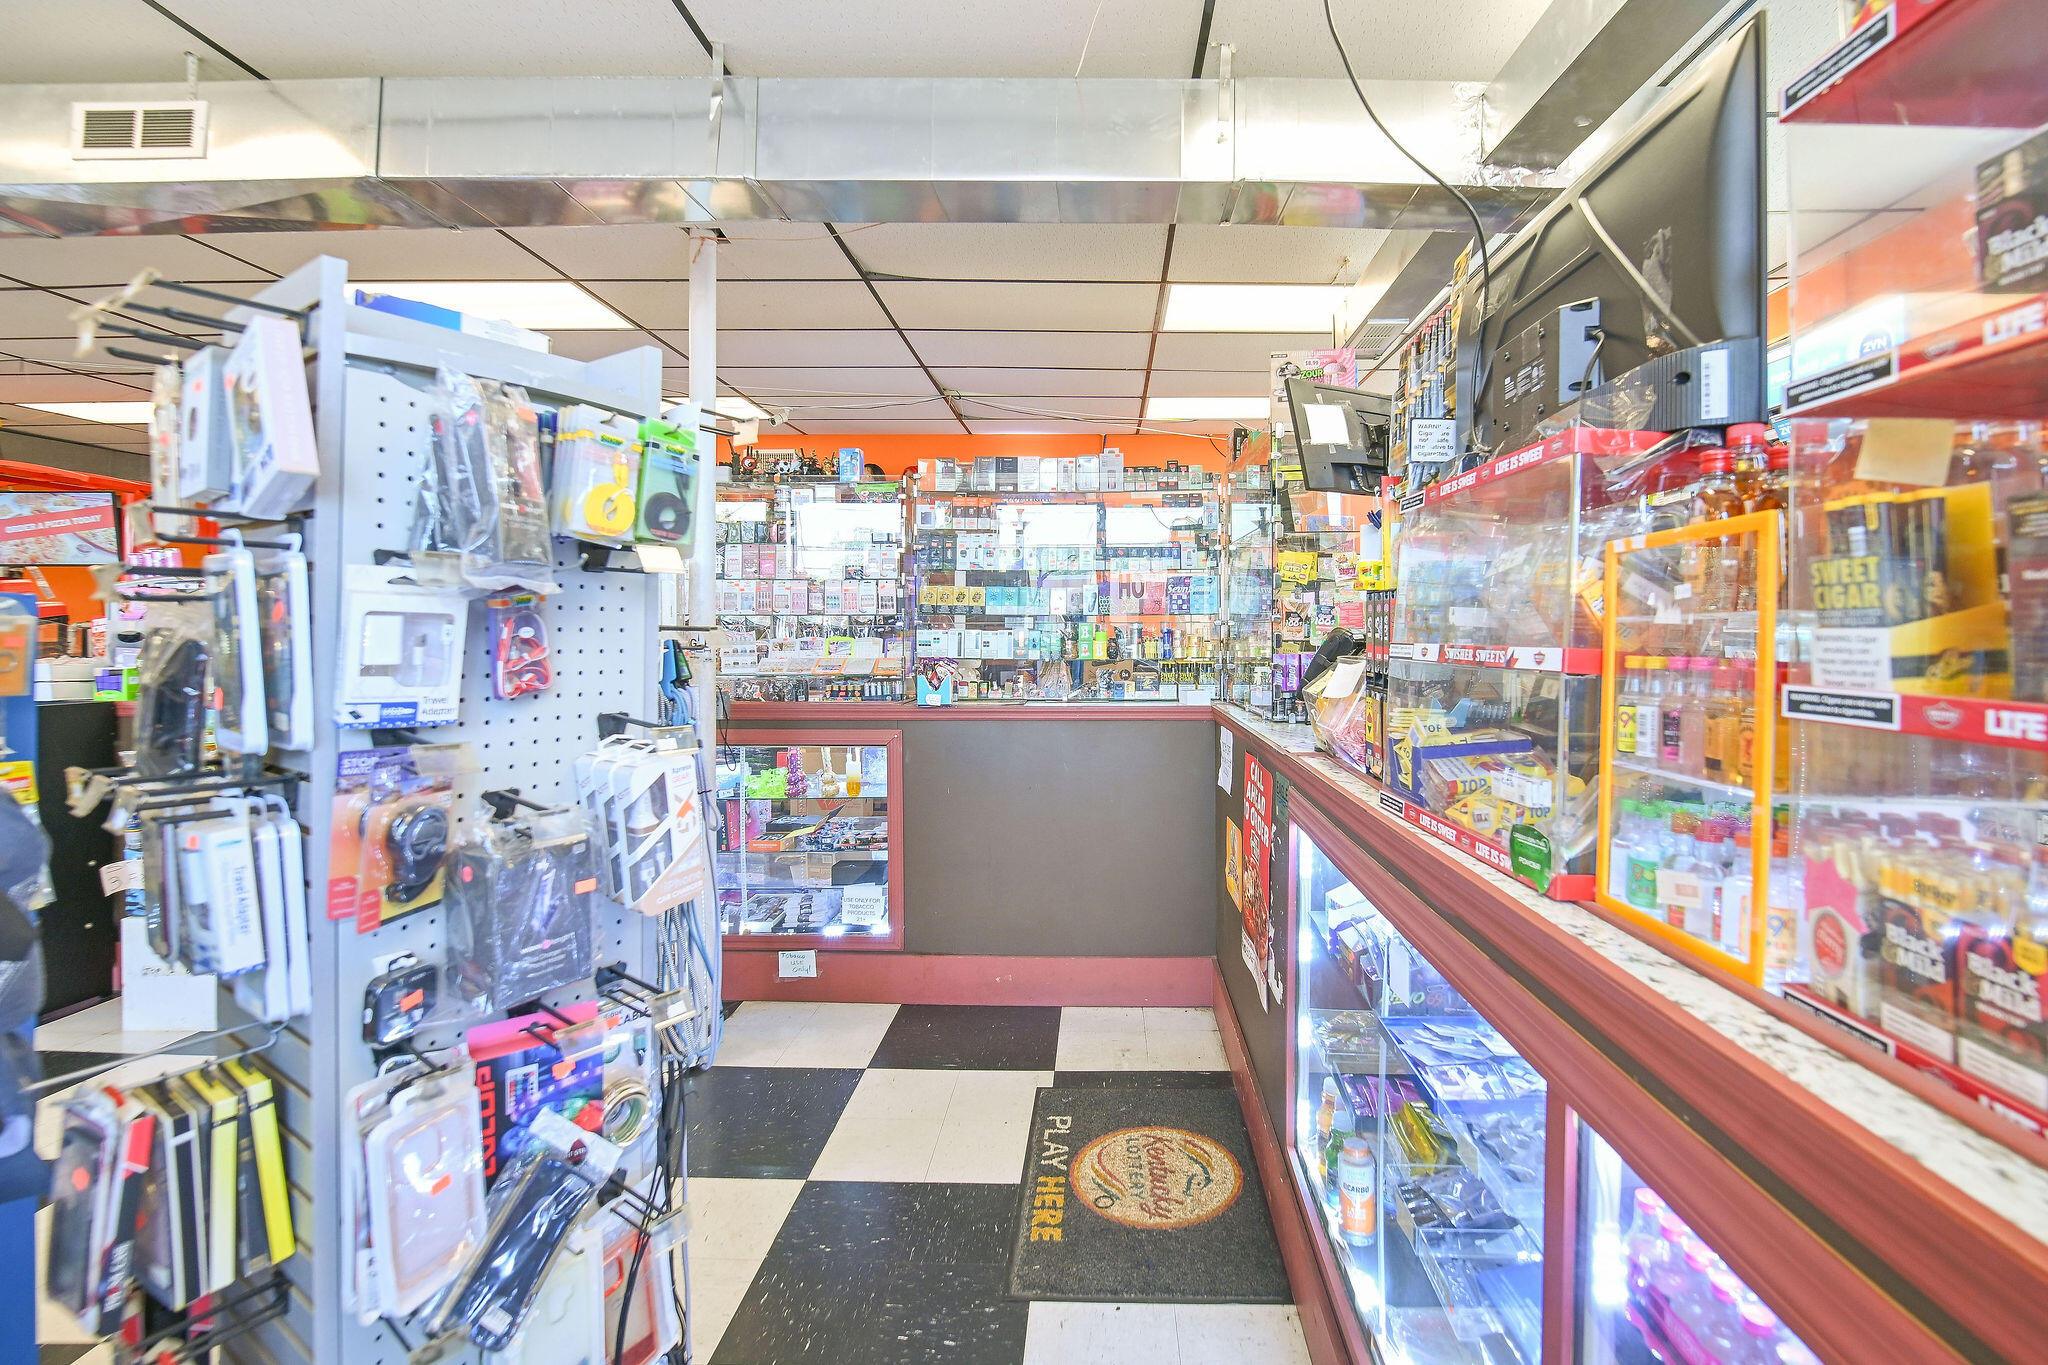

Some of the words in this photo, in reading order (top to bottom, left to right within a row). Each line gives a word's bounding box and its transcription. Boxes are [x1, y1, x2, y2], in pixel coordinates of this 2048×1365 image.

[1300, 368, 1324, 379] ZOUR
[1495, 458, 1510, 476] LIFE
[1509, 455, 1519, 470] IS
[1518, 445, 1545, 466] SWEET
[1440, 482, 1452, 496] LIFE
[1458, 472, 1477, 489] SWEET
[1811, 556, 1880, 586] SWEET
[1813, 582, 1881, 609] CIGAR
[1445, 647, 1474, 661] SWISHER
[1475, 649, 1506, 663] SWEETS
[1287, 664, 1297, 688] Super
[1985, 708, 2048, 742] LIFE
[342, 767, 371, 775] WATC
[1250, 761, 1264, 793] CALL
[1246, 781, 1266, 817] AHEAD
[1530, 806, 1551, 819] TOP
[1250, 807, 1269, 848] ORDER
[1420, 813, 1431, 829] LIFE
[1437, 824, 1457, 842] SWEET
[1476, 841, 1490, 859] LIFE
[1490, 849, 1499, 864] IS
[1885, 922, 1944, 960] Black
[1896, 947, 1946, 983] Mild
[1967, 952, 2040, 993] Black
[1978, 978, 2042, 1022] Mild
[1037, 1115, 1072, 1171] PLAY
[1125, 1137, 1146, 1200] LOTTERY
[1140, 1134, 1185, 1220] Kentucky
[1030, 1176, 1066, 1242] HERE
